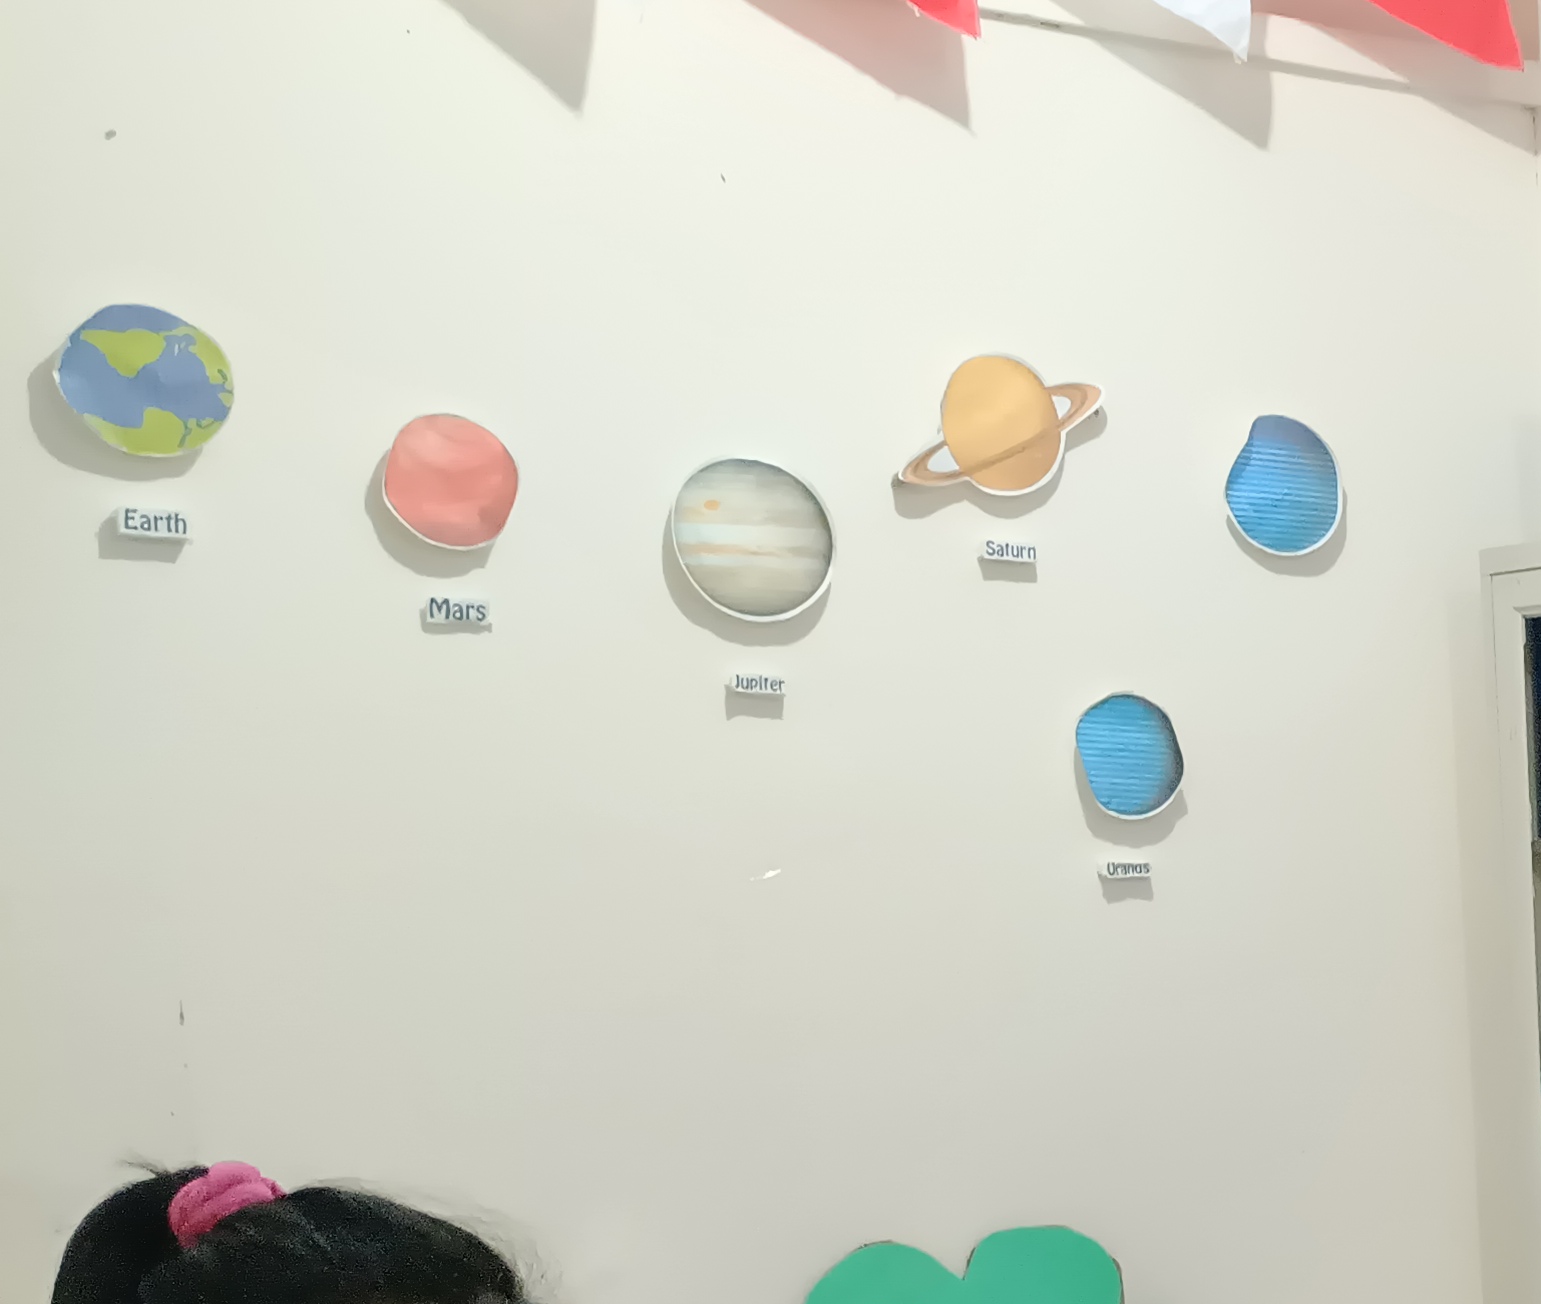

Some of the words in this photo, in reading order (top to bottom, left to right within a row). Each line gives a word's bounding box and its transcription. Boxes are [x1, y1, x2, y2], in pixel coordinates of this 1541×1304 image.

[124, 507, 187, 534] Earth
[985, 540, 1037, 560] Saturn
[429, 597, 487, 622] Mars
[735, 674, 785, 693] Jupiter
